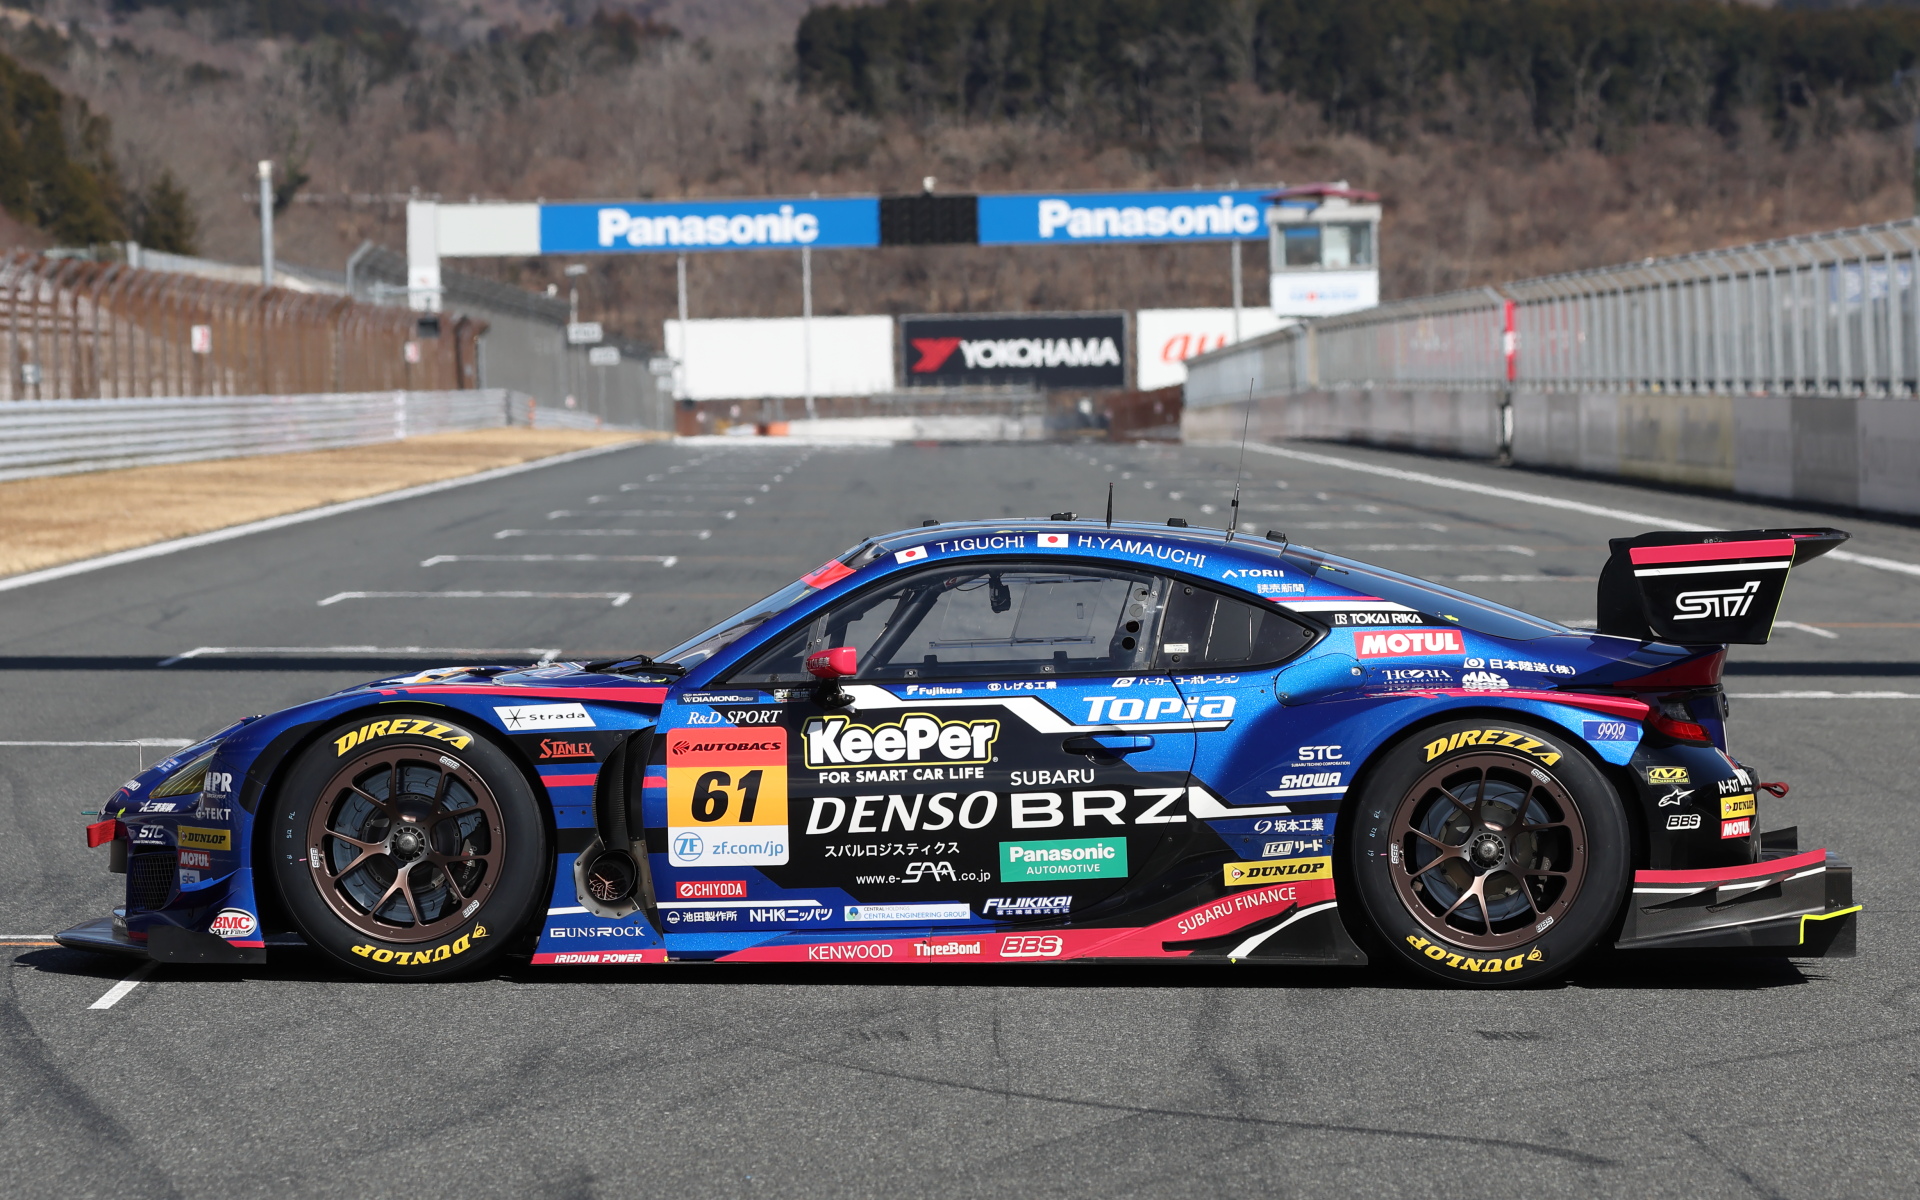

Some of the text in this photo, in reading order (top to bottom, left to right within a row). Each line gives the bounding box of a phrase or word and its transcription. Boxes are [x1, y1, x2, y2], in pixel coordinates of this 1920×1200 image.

[598, 204, 820, 247] Panasonic
[1037, 196, 1260, 238] Panasonic
[958, 337, 1120, 368] YOKOHAMA
[936, 536, 1025, 553] T.IGUCHI
[1077, 536, 1207, 569] H.YAMAUCHI
[1351, 613, 1424, 625] TOKAI RIKA
[1361, 632, 1460, 655] MOTUL
[918, 685, 963, 696] Fujikura
[1003, 681, 1057, 691] しげる工業
[529, 711, 586, 721] Strada
[686, 710, 783, 725] R&D SPORT
[333, 718, 473, 758] DIREZZA
[691, 741, 782, 752] AUTOBACS
[806, 716, 994, 765] KeePer
[1298, 745, 1343, 761] STC
[1423, 729, 1562, 767] DIREZZA
[819, 767, 985, 784] FOR SMART CAR LIFE
[1010, 768, 1095, 786] SUBARU
[1279, 772, 1342, 788] SHOWA
[691, 770, 764, 823] 61
[805, 790, 998, 835] DENSO
[1010, 787, 1188, 829] BRZ
[1274, 818, 1324, 833] 坂本工業
[1666, 814, 1701, 830] BBS
[1723, 820, 1750, 837] MOTUL
[139, 824, 164, 839] STC
[187, 832, 227, 845] DUNLOP
[676, 838, 701, 856] ZF
[712, 840, 784, 857] zf.com/jp
[824, 841, 961, 858] スバルロジスティクス
[1009, 842, 1115, 863] Panasonic
[1294, 838, 1324, 854] リード
[180, 851, 210, 867] MOTUL
[1026, 863, 1101, 875] AUTOMOTIVE
[1246, 862, 1325, 878] DUNLOP
[694, 883, 743, 896] CHIYODA
[982, 895, 1073, 914] FUJIKIKAI
[1177, 886, 1297, 935] SUBARU FINANCE
[212, 916, 251, 930] BMC
[682, 911, 738, 923] 池田製作所
[863, 910, 967, 920] CENTRAL ENGINEERING GROUP
[351, 932, 471, 965] DUNLOP
[808, 944, 893, 960] KENWOOD
[913, 942, 981, 957] ThreeBond
[1000, 935, 1063, 957] BBS
[1405, 934, 1525, 973] DUNLOP
[554, 953, 643, 964] IRIDIUM POWER
